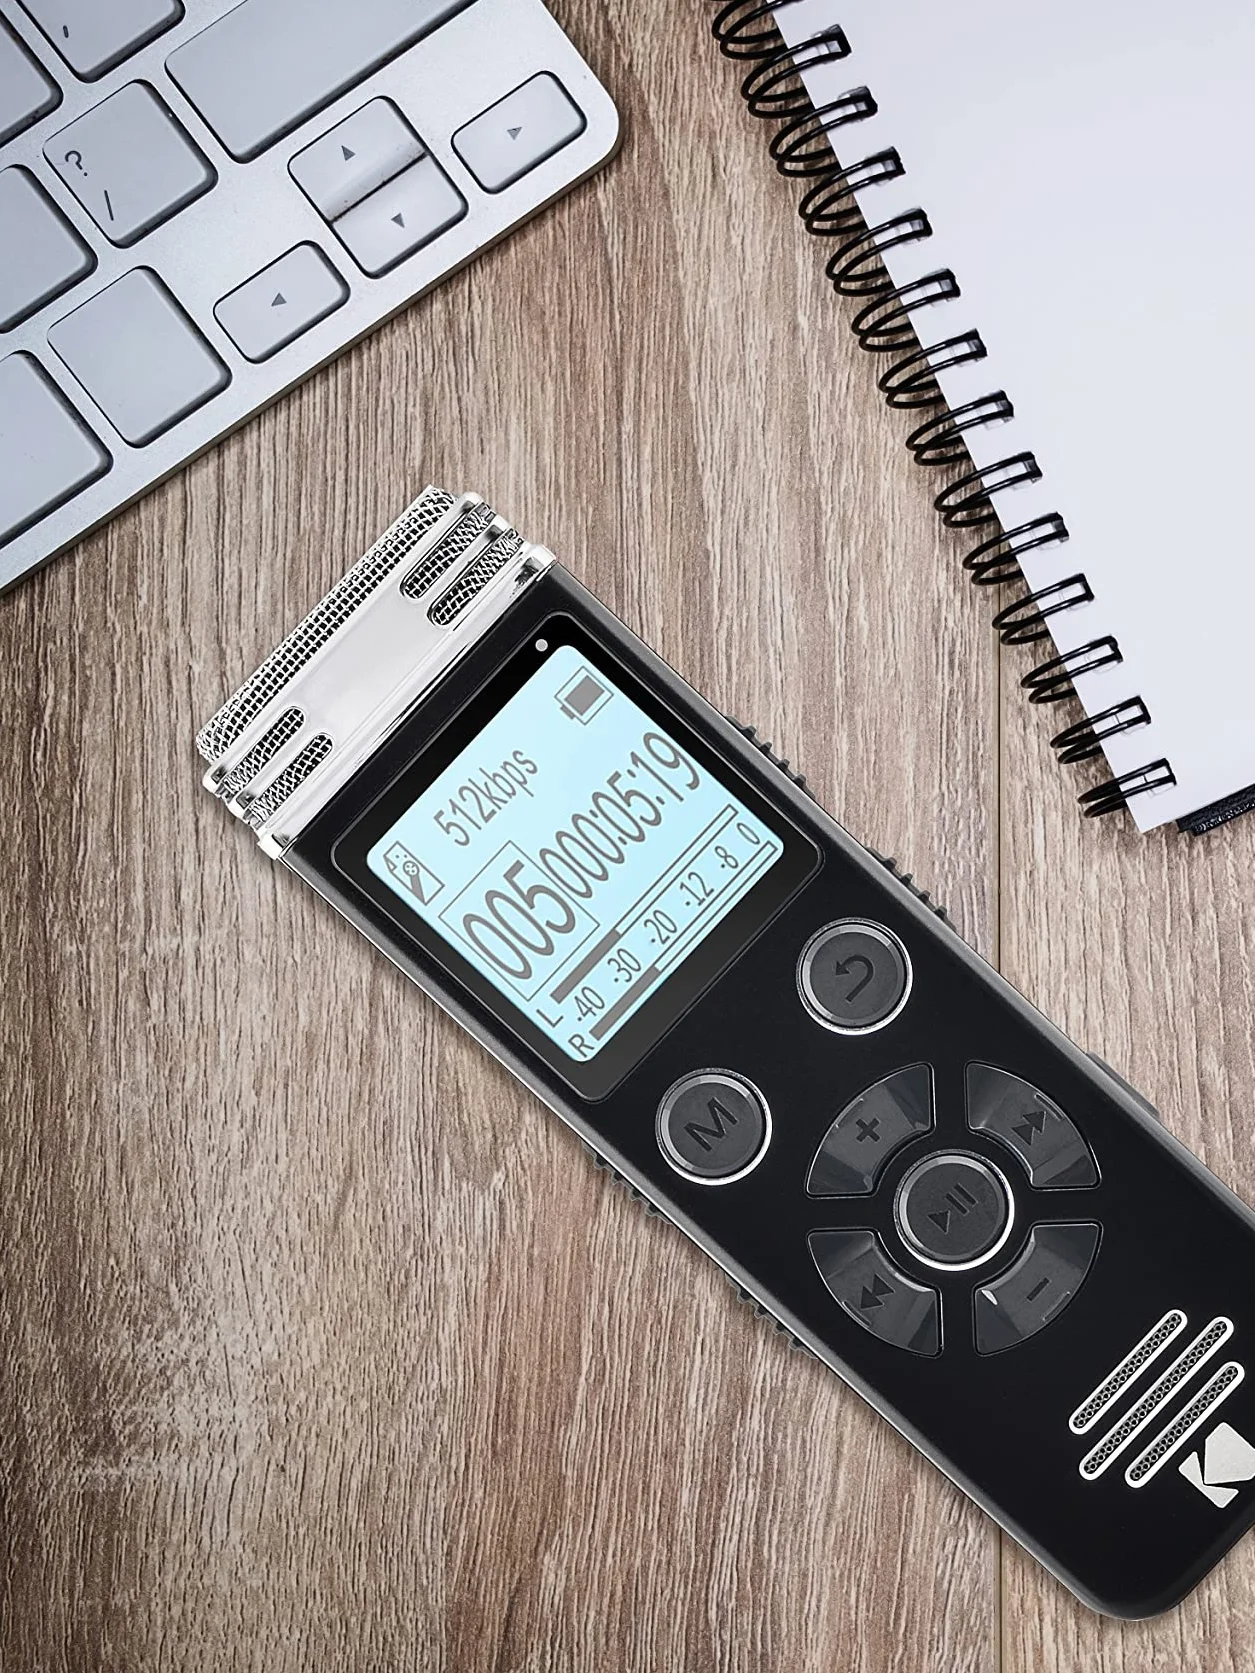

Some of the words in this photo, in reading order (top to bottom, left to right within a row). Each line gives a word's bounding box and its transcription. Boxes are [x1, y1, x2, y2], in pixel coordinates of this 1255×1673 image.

[64, 150, 88, 177] ?
[434, 749, 539, 847] 512kbps
[736, 822, 761, 846] 0
[462, 859, 577, 981] 005
[538, 731, 701, 899] 000:05:19
[535, 1006, 564, 1029] L
[567, 1032, 596, 1058] R
[684, 1097, 738, 1151] M
